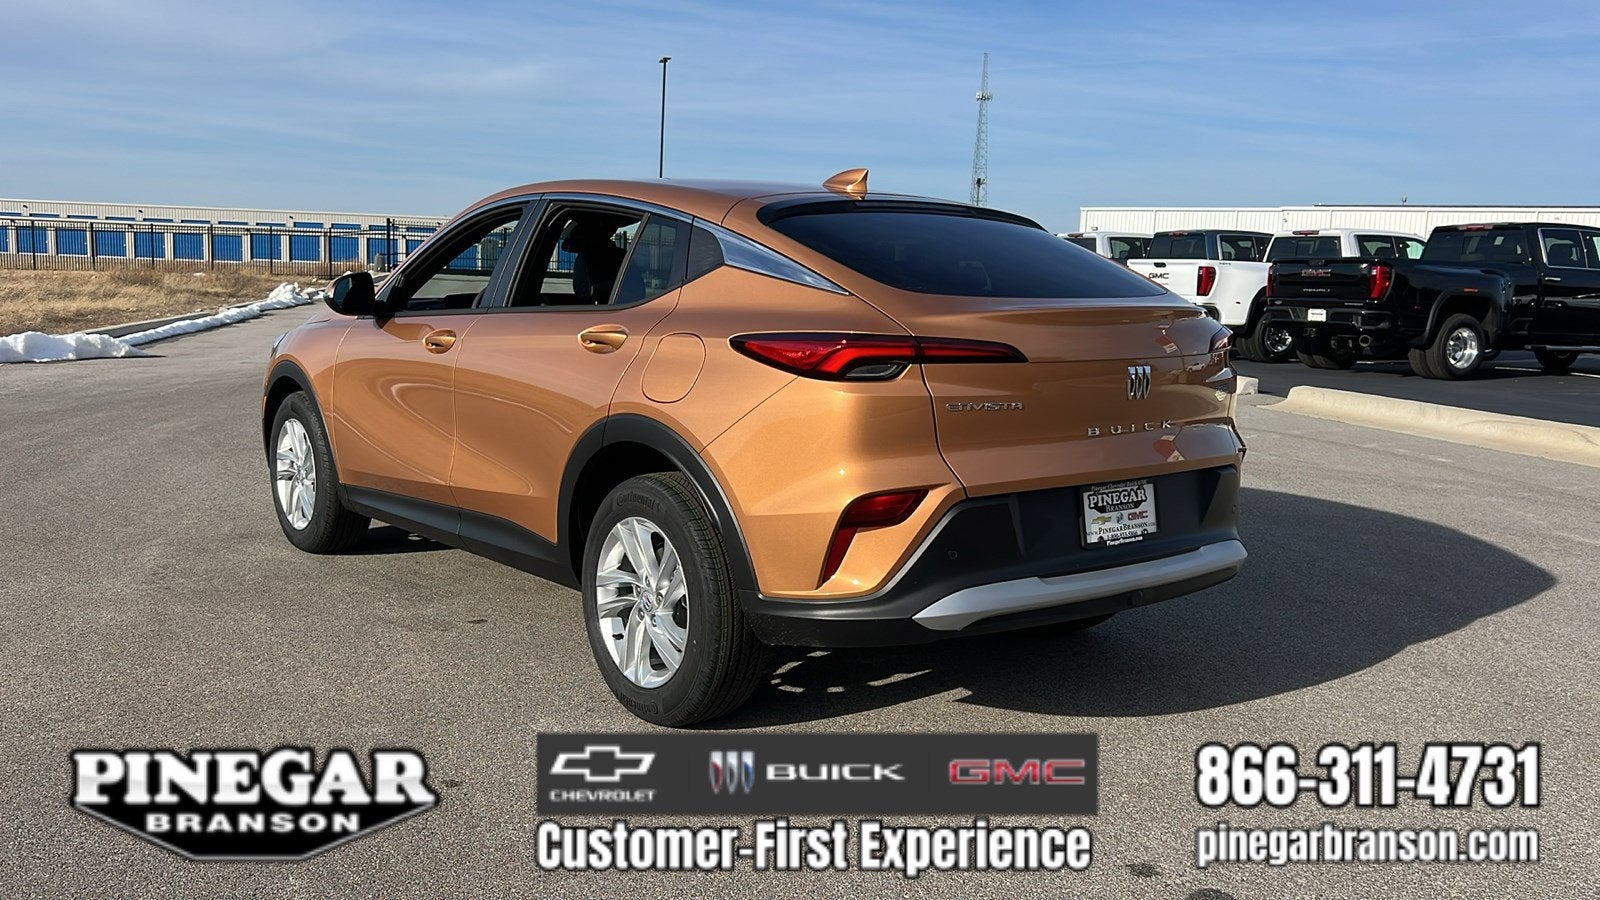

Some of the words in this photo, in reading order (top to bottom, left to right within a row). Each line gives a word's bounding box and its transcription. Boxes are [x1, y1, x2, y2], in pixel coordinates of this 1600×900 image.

[1301, 269, 1332, 277] GMC
[945, 402, 1024, 412] ENVISTA
[1088, 420, 1172, 437] BUICK
[1089, 489, 1147, 508] PINEGAR
[1128, 511, 1148, 521] GMC
